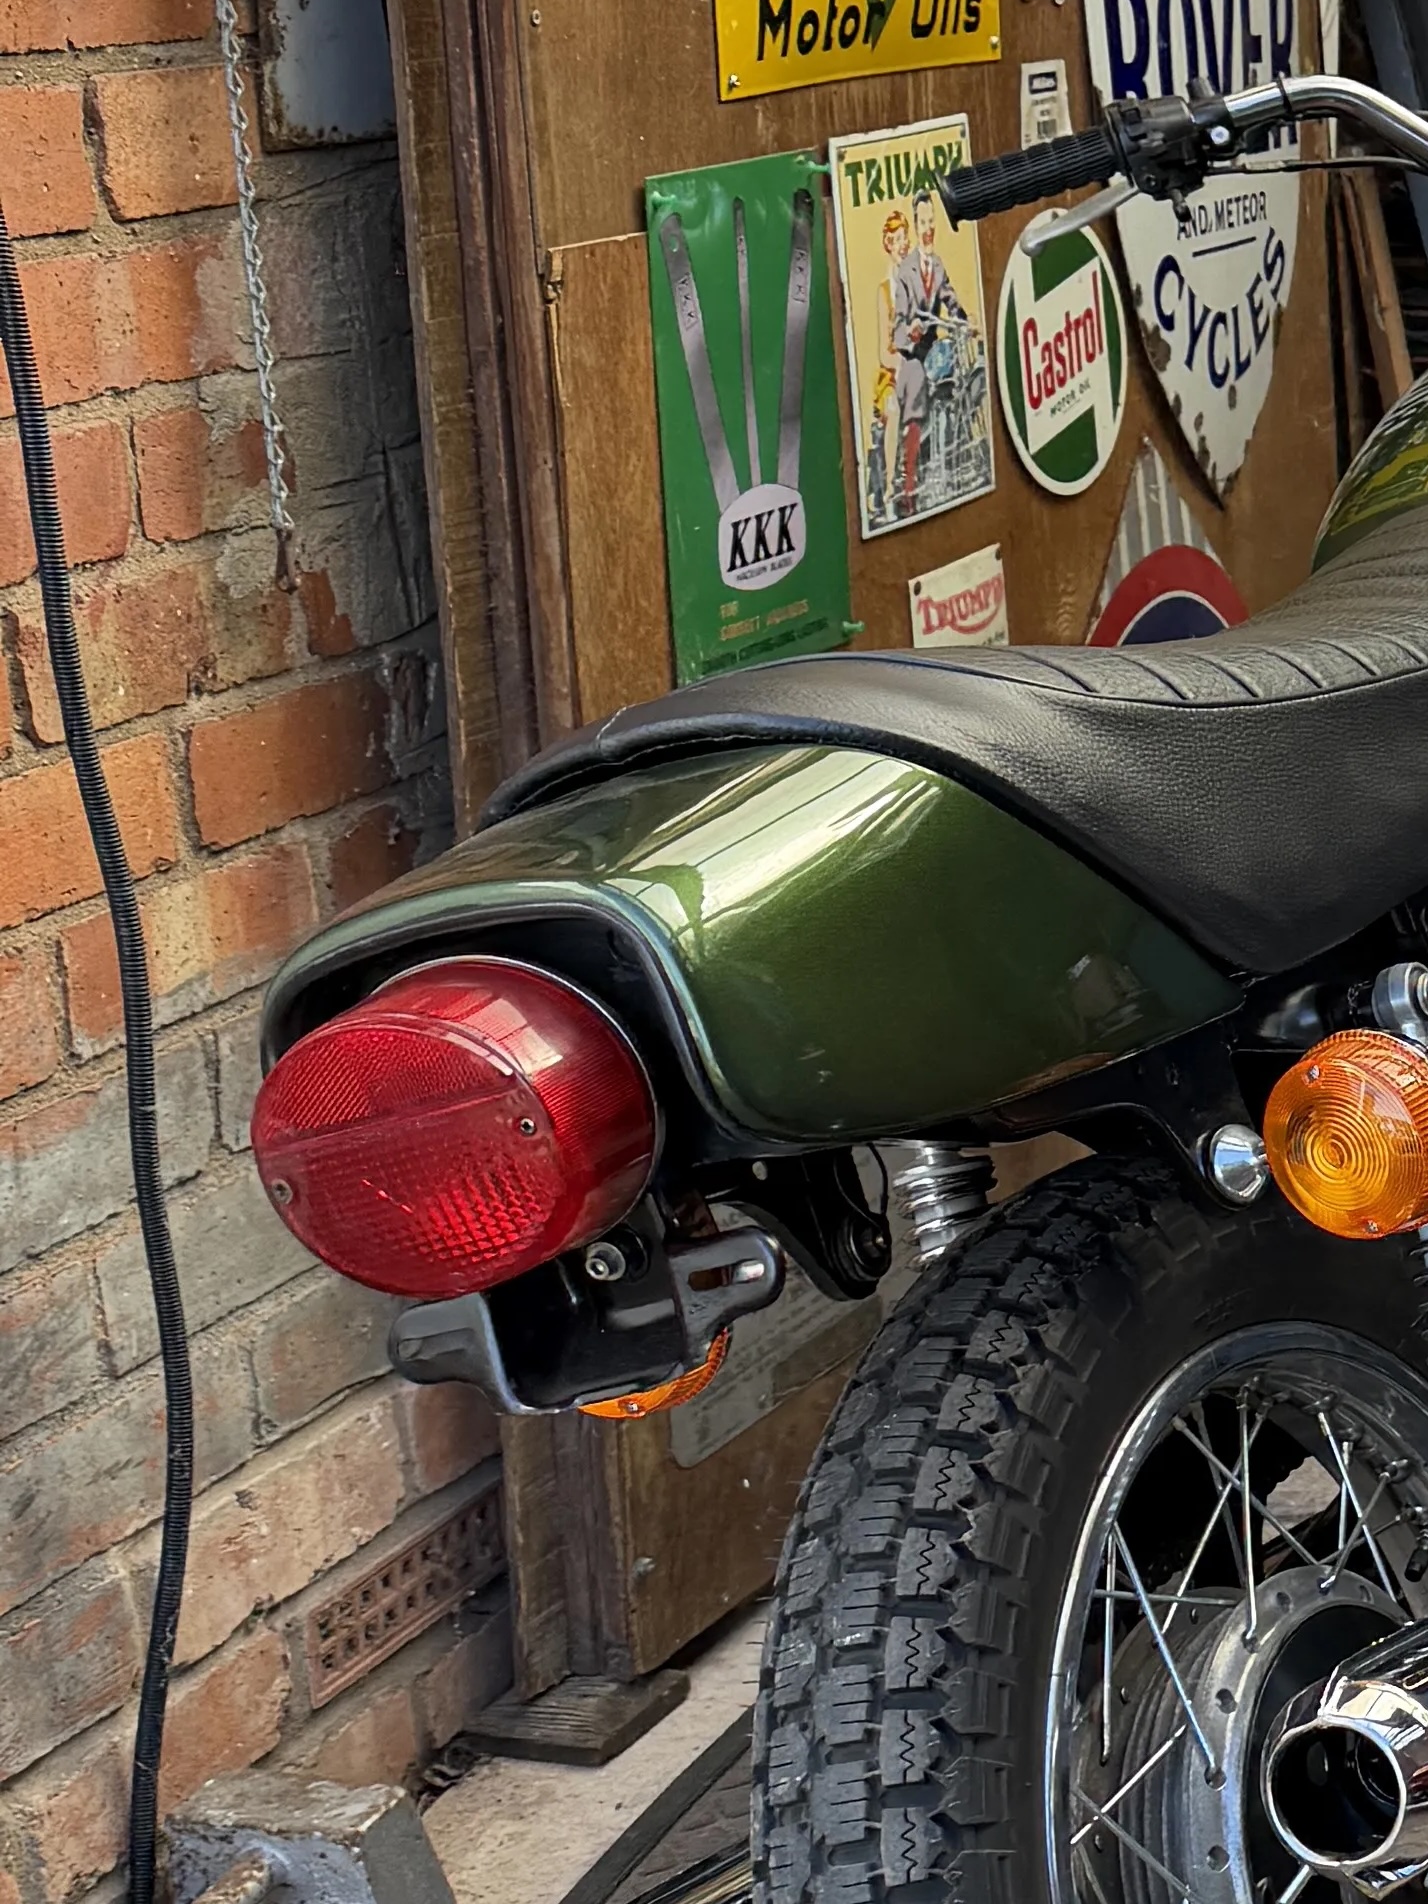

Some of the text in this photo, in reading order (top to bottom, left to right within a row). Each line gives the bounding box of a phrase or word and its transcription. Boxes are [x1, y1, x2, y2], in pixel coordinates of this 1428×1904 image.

[844, 141, 962, 208] TRIUMPH
[1214, 191, 1267, 232] METEOR
[1022, 269, 1104, 410] Castrol
[1154, 226, 1285, 389] CYCLES
[726, 502, 799, 572] KKK
